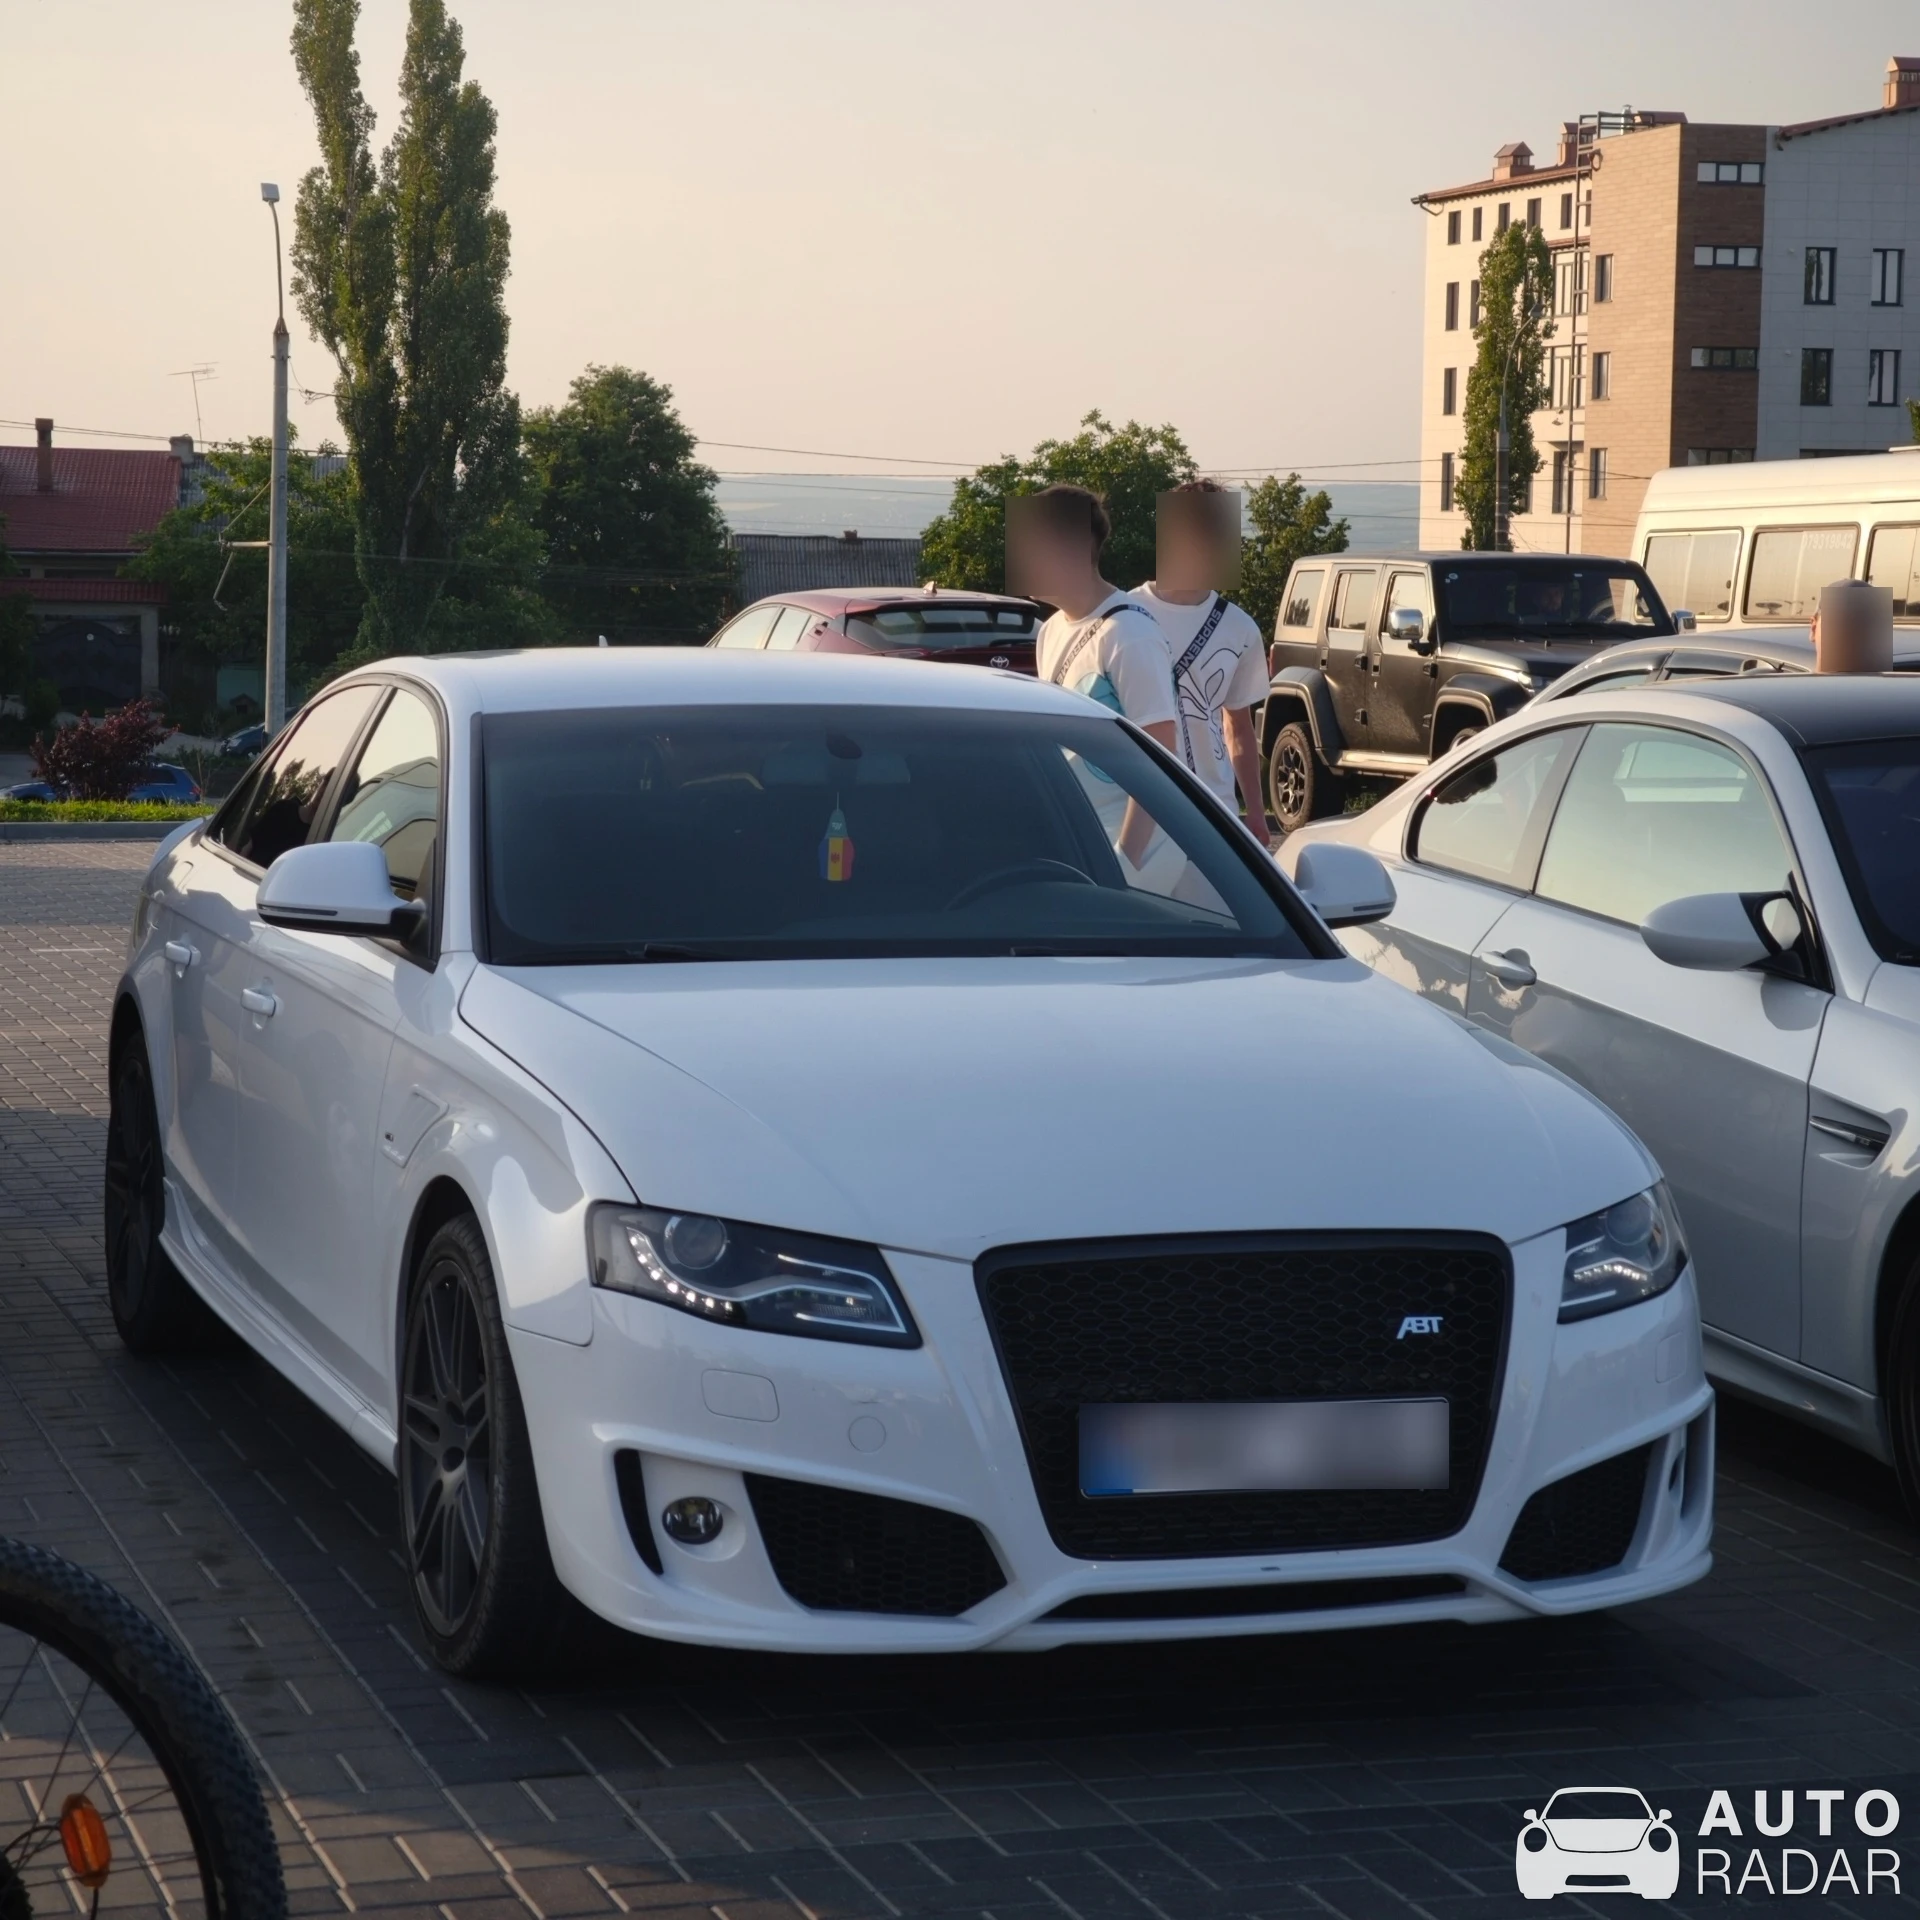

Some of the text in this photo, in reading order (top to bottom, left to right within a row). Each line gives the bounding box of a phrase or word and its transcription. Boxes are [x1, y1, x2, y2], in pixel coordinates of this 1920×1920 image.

[1055, 617, 1104, 686] SUPREME
[1176, 608, 1222, 676] SUPREME
[1396, 1316, 1443, 1340] ABT
